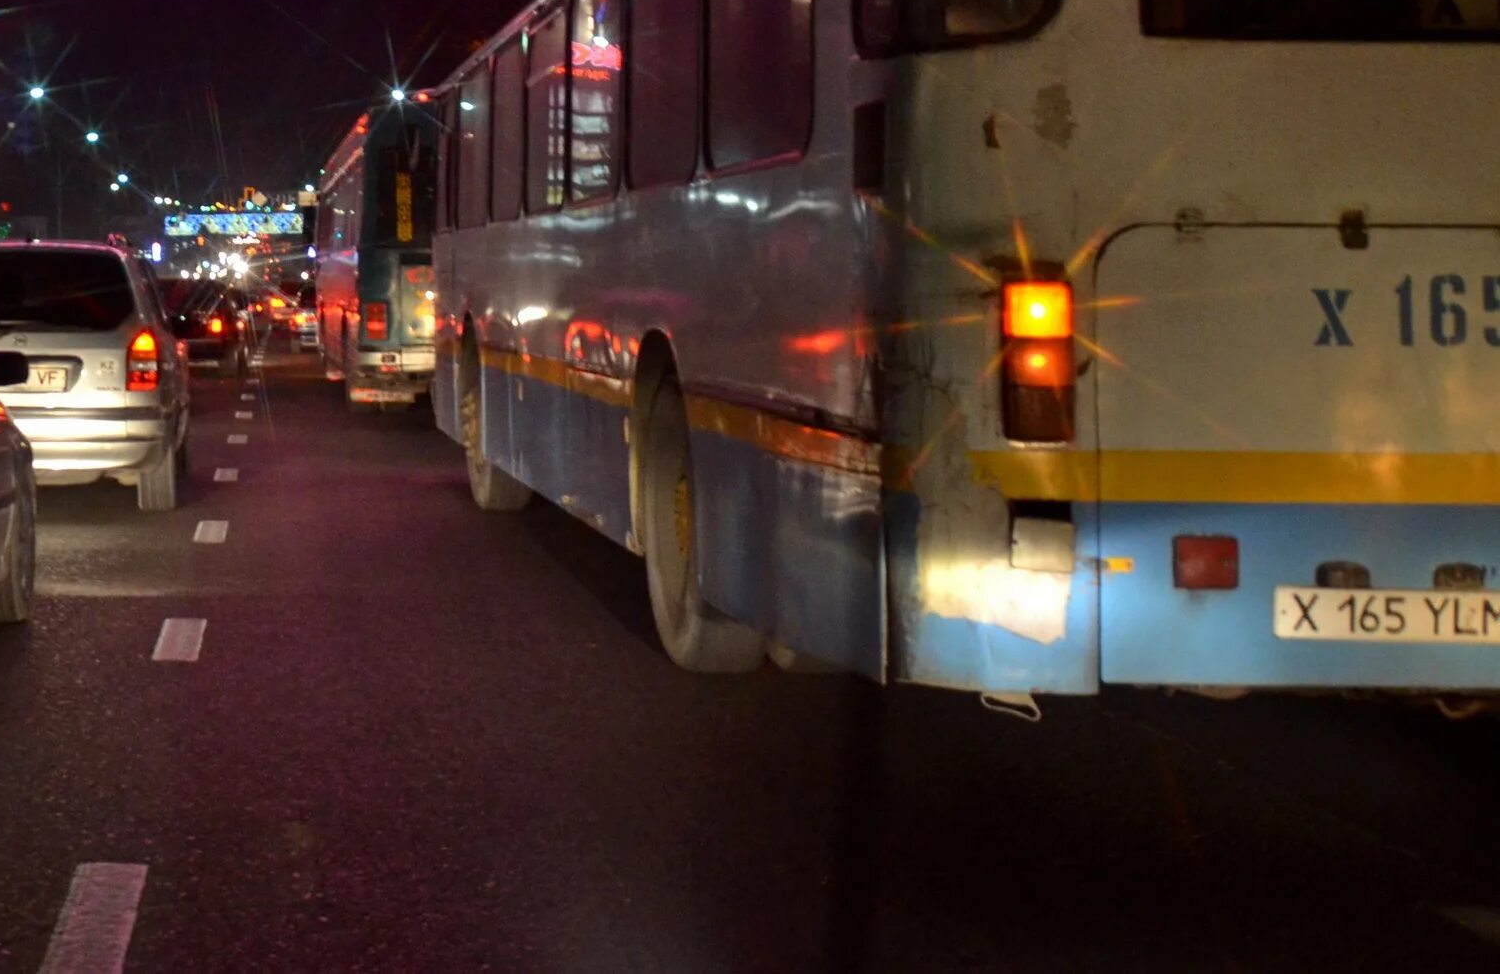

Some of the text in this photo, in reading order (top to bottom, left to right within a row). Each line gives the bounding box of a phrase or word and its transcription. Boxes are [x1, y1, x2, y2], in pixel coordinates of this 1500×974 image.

[1311, 288, 1353, 347] X
[1292, 592, 1319, 631] X
[1336, 594, 1407, 634] 165
